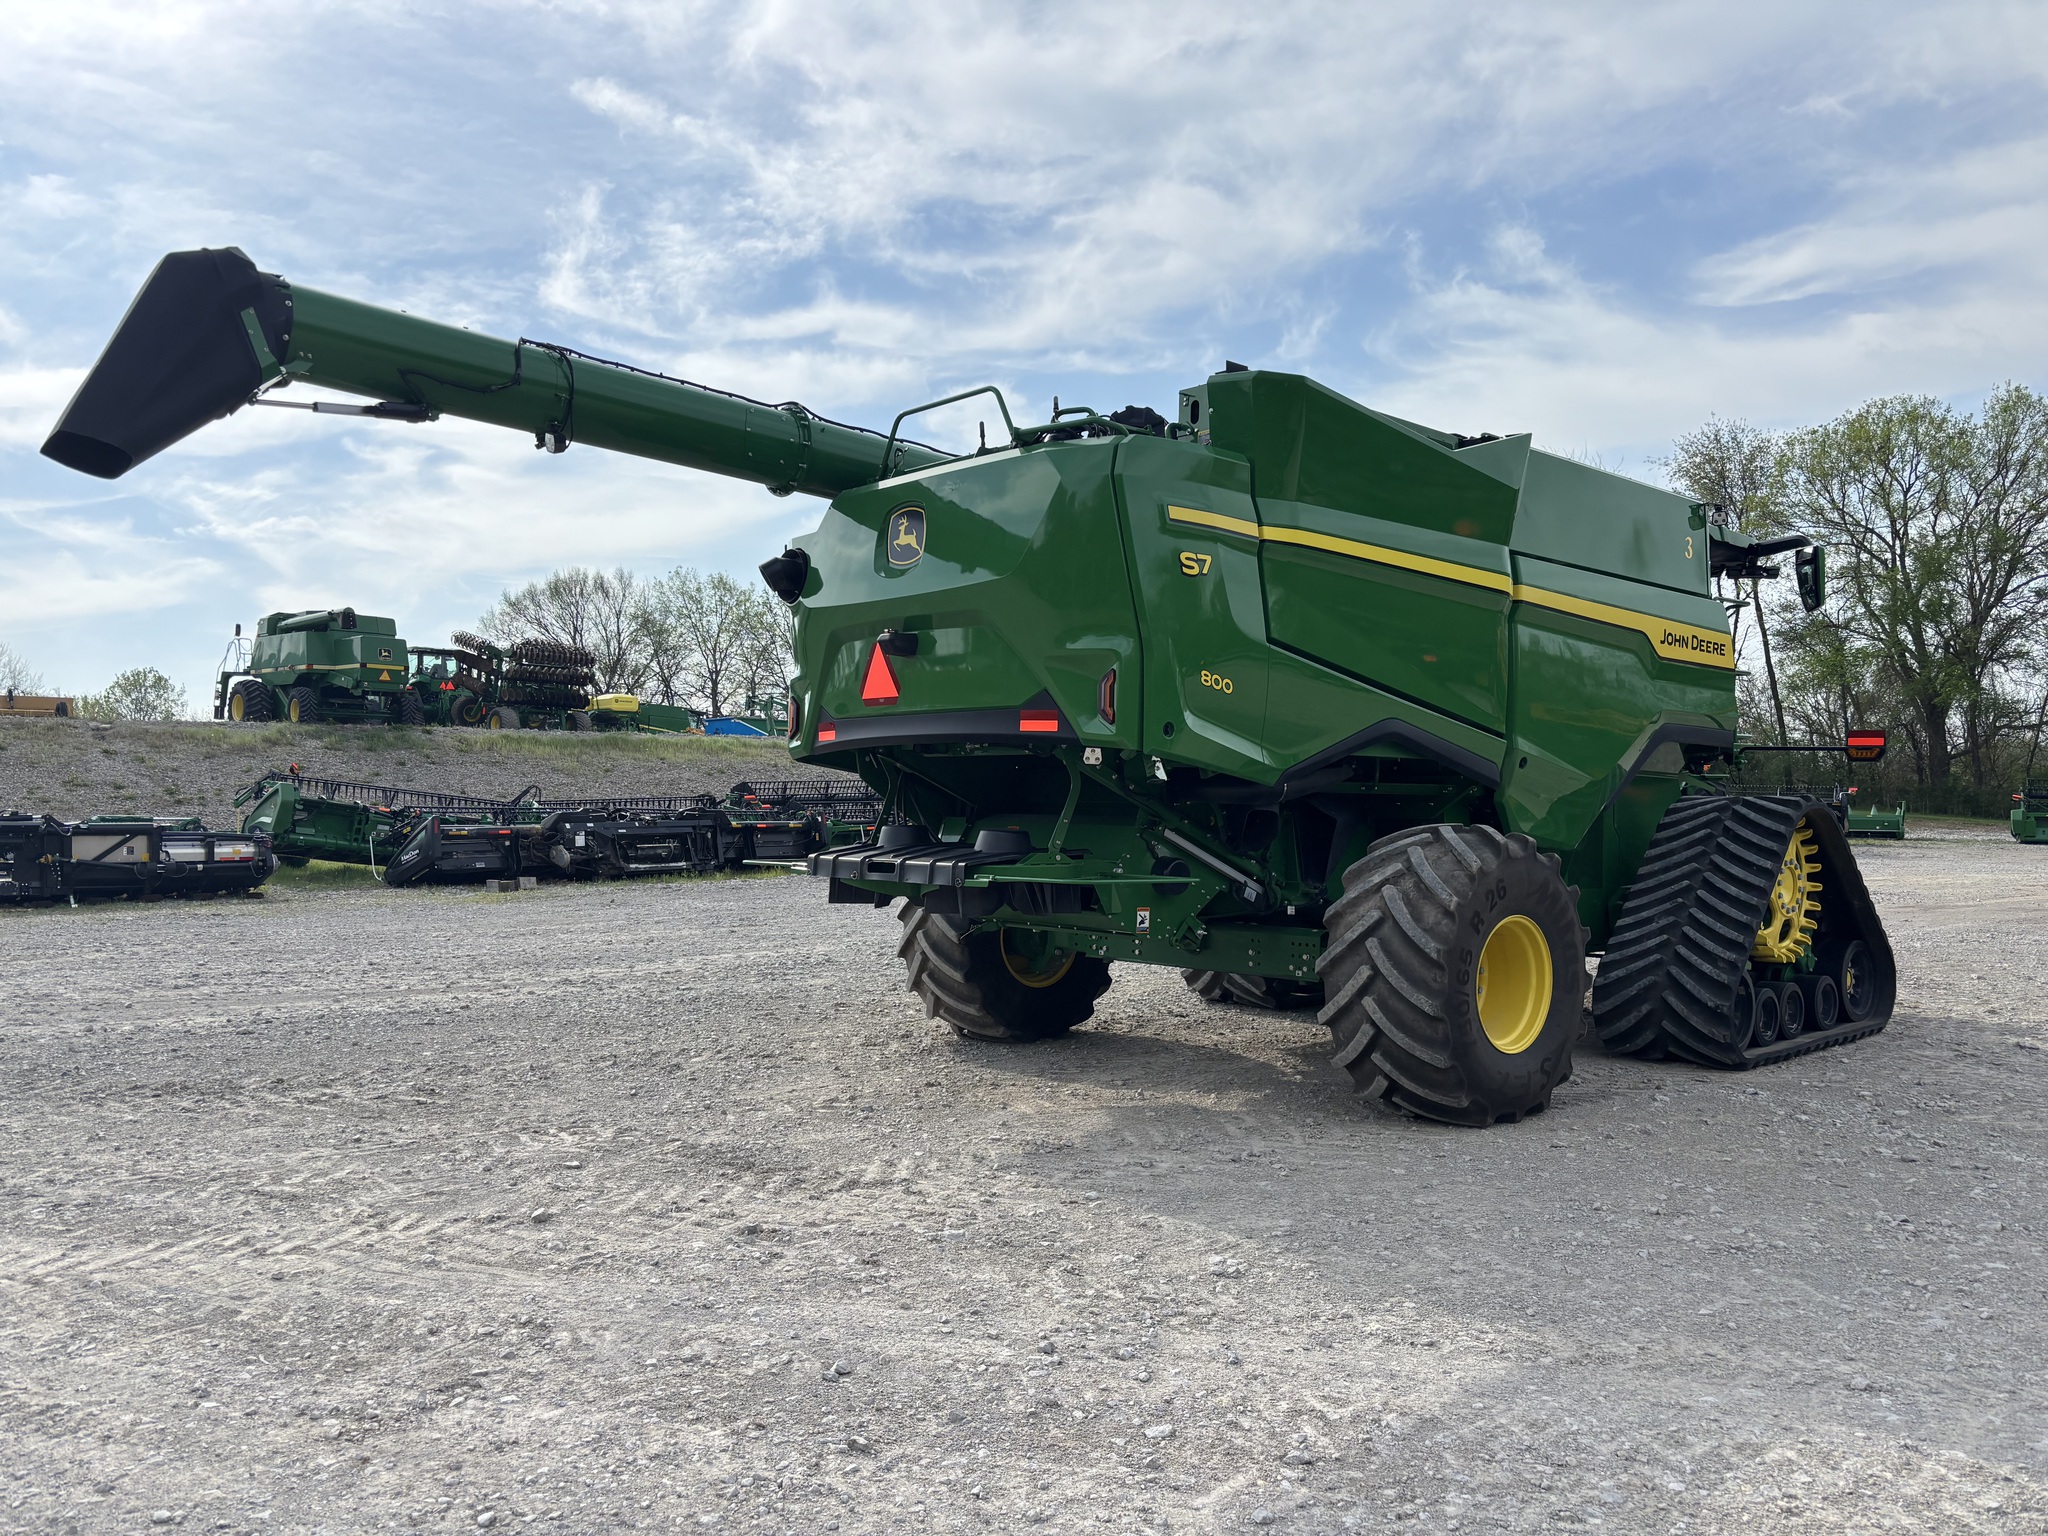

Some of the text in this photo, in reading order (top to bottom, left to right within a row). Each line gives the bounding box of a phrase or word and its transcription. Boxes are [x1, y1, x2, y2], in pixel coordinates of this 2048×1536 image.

[1685, 536, 1693, 559] 3
[1179, 551, 1212, 577] S7
[1660, 629, 1726, 656] JOHN DEERE
[1200, 670, 1233, 694] 800
[1470, 910, 1485, 936] R
[1485, 878, 1508, 914] 26
